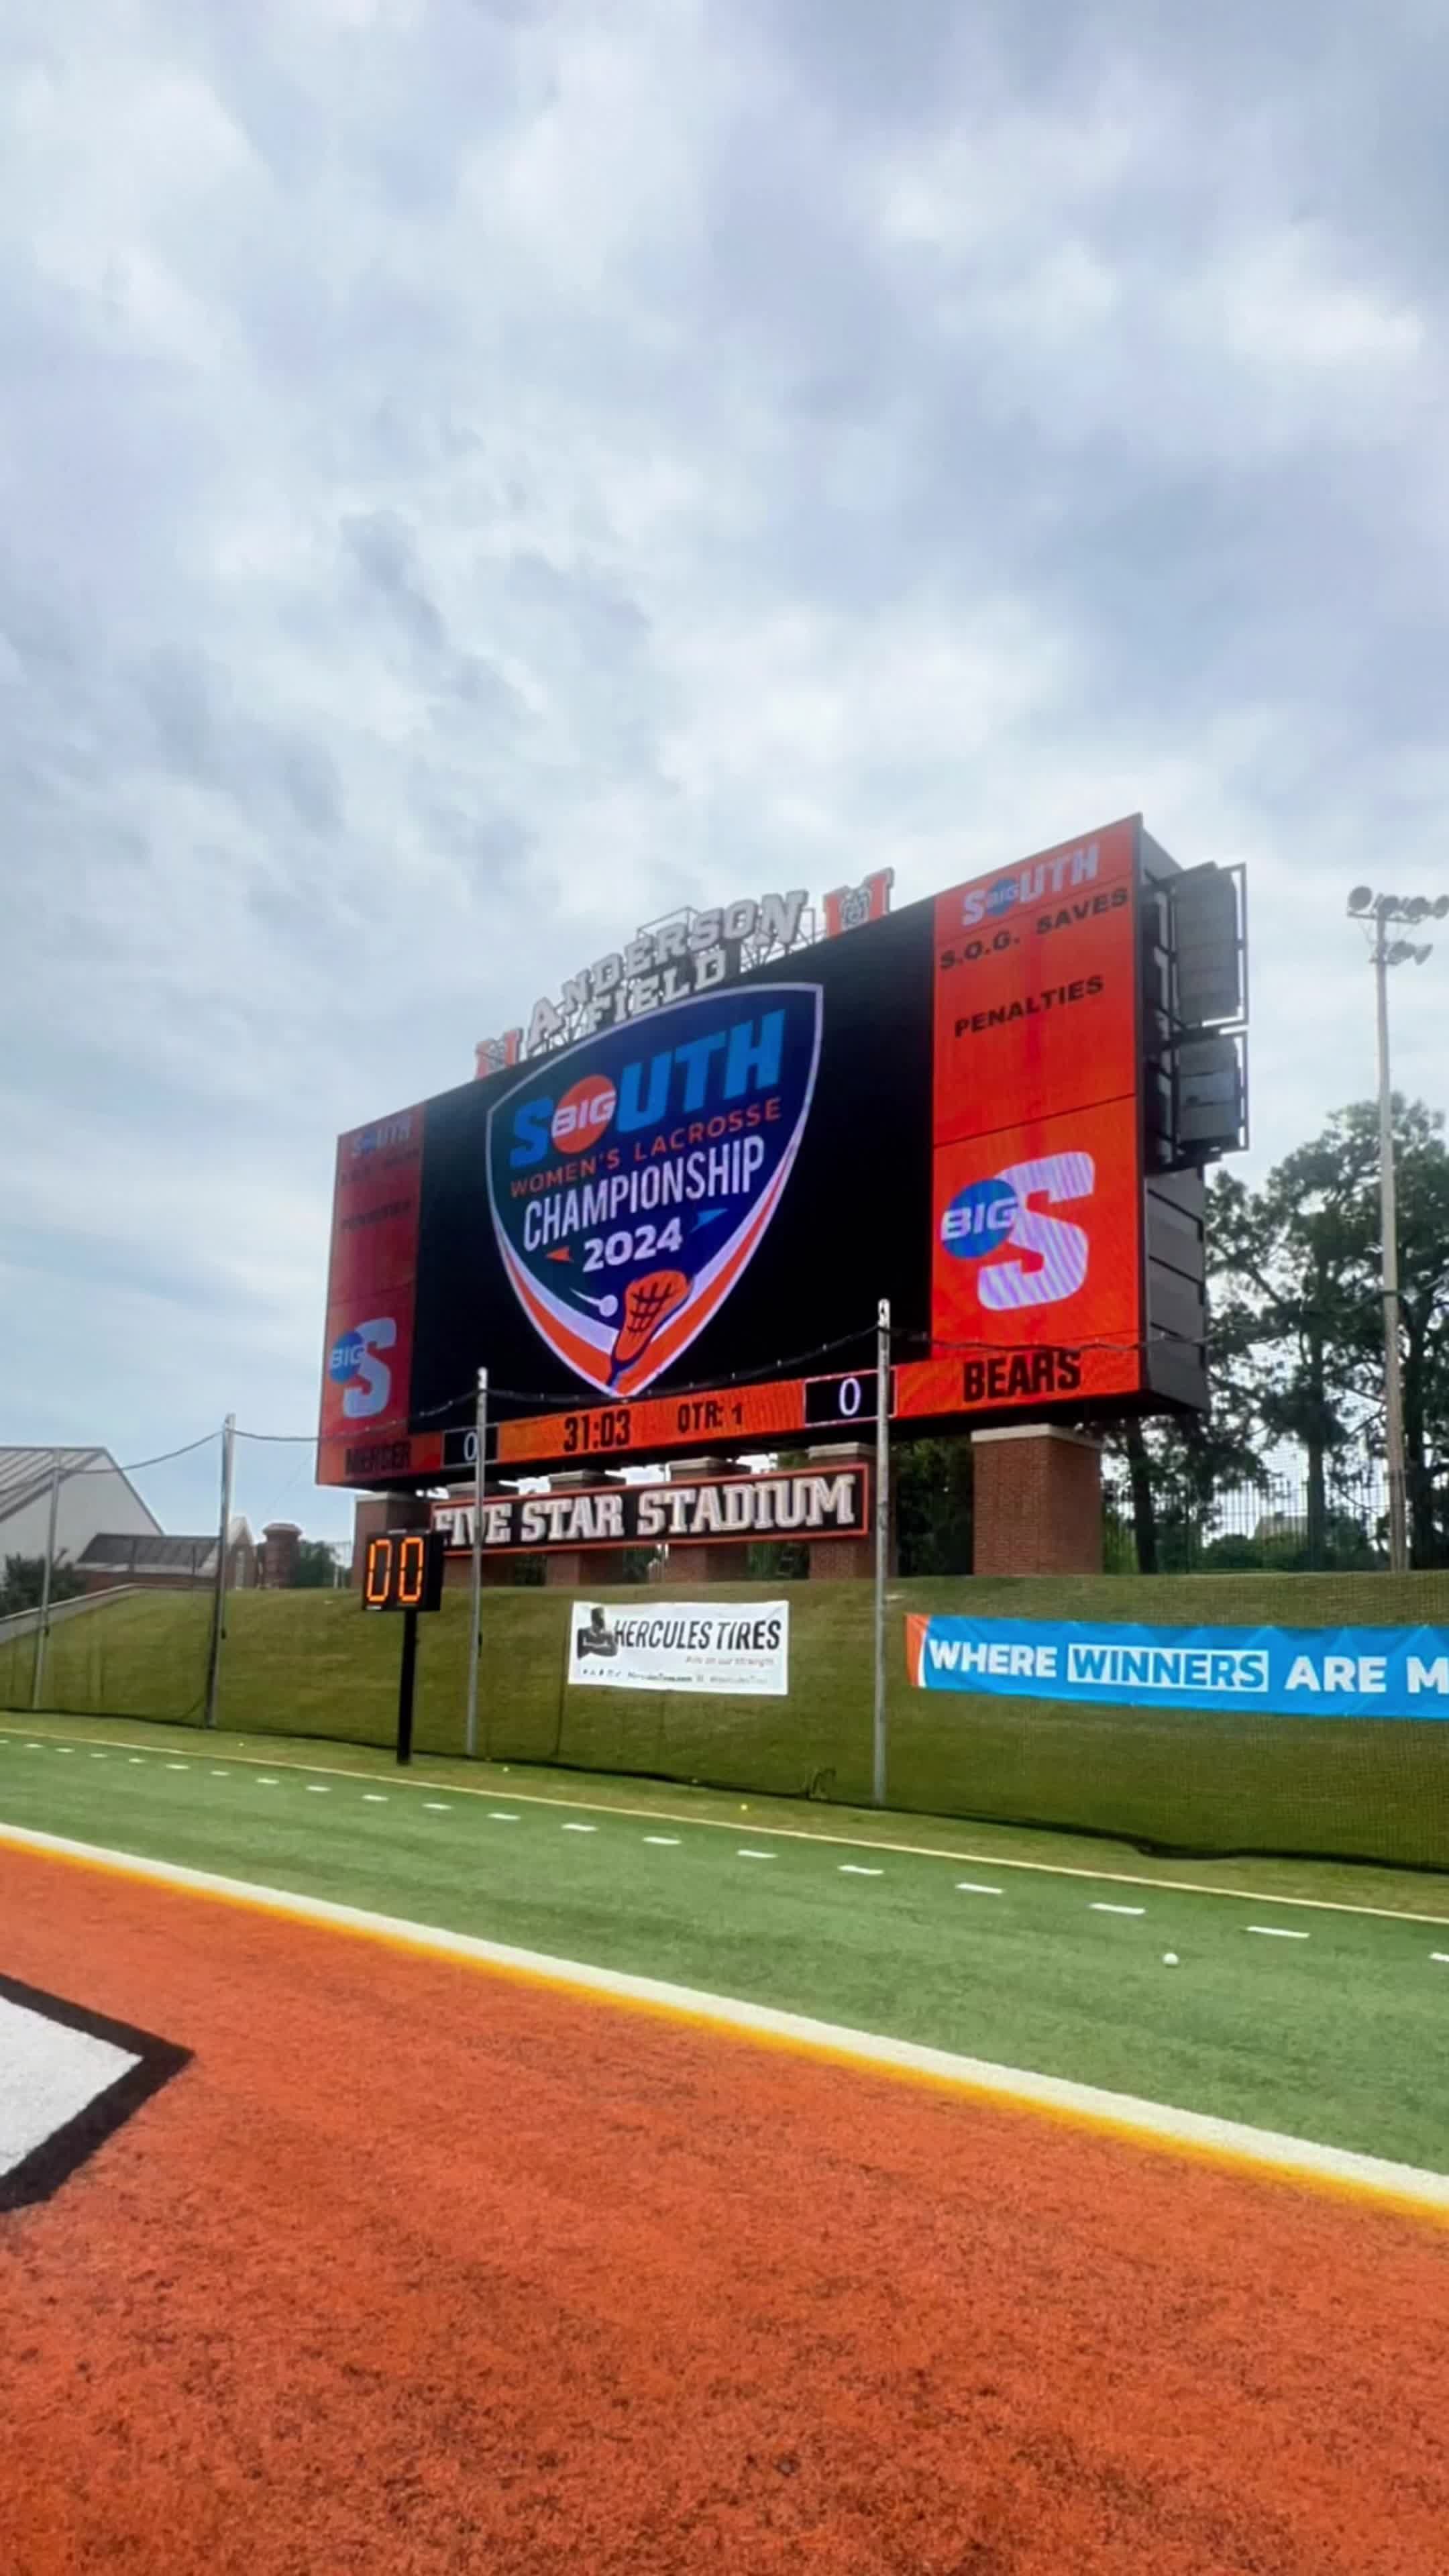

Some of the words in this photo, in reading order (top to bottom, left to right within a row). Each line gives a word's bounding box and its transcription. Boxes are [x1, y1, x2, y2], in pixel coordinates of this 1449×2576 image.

[1036, 887, 1128, 934] SAVES
[527, 890, 808, 1053] ANDERSON
[582, 948, 726, 1033] FIELD
[954, 975, 1104, 1038] PENALTIES
[551, 1090, 616, 1138] BIG
[511, 1148, 621, 1197] WOMEN'S
[635, 1097, 782, 1161] LACROSSE
[523, 1135, 765, 1252] CHAMPIONSHIP
[941, 1197, 1020, 1240] BIG
[582, 1218, 683, 1273] 2024
[331, 1344, 366, 1368] BIG
[963, 1351, 1081, 1403] BEARS
[839, 1377, 861, 1416] 0
[563, 1410, 631, 1452] 31:03
[521, 1494, 625, 1542] STAR
[637, 1475, 855, 1537] STADIUM
[614, 1619, 713, 1650] HERCULES
[716, 1619, 782, 1650] TIRES
[930, 1639, 1057, 1678] WHERE
[1073, 1648, 1264, 1688] WINNERS
[1285, 1656, 1387, 1693] ARE
